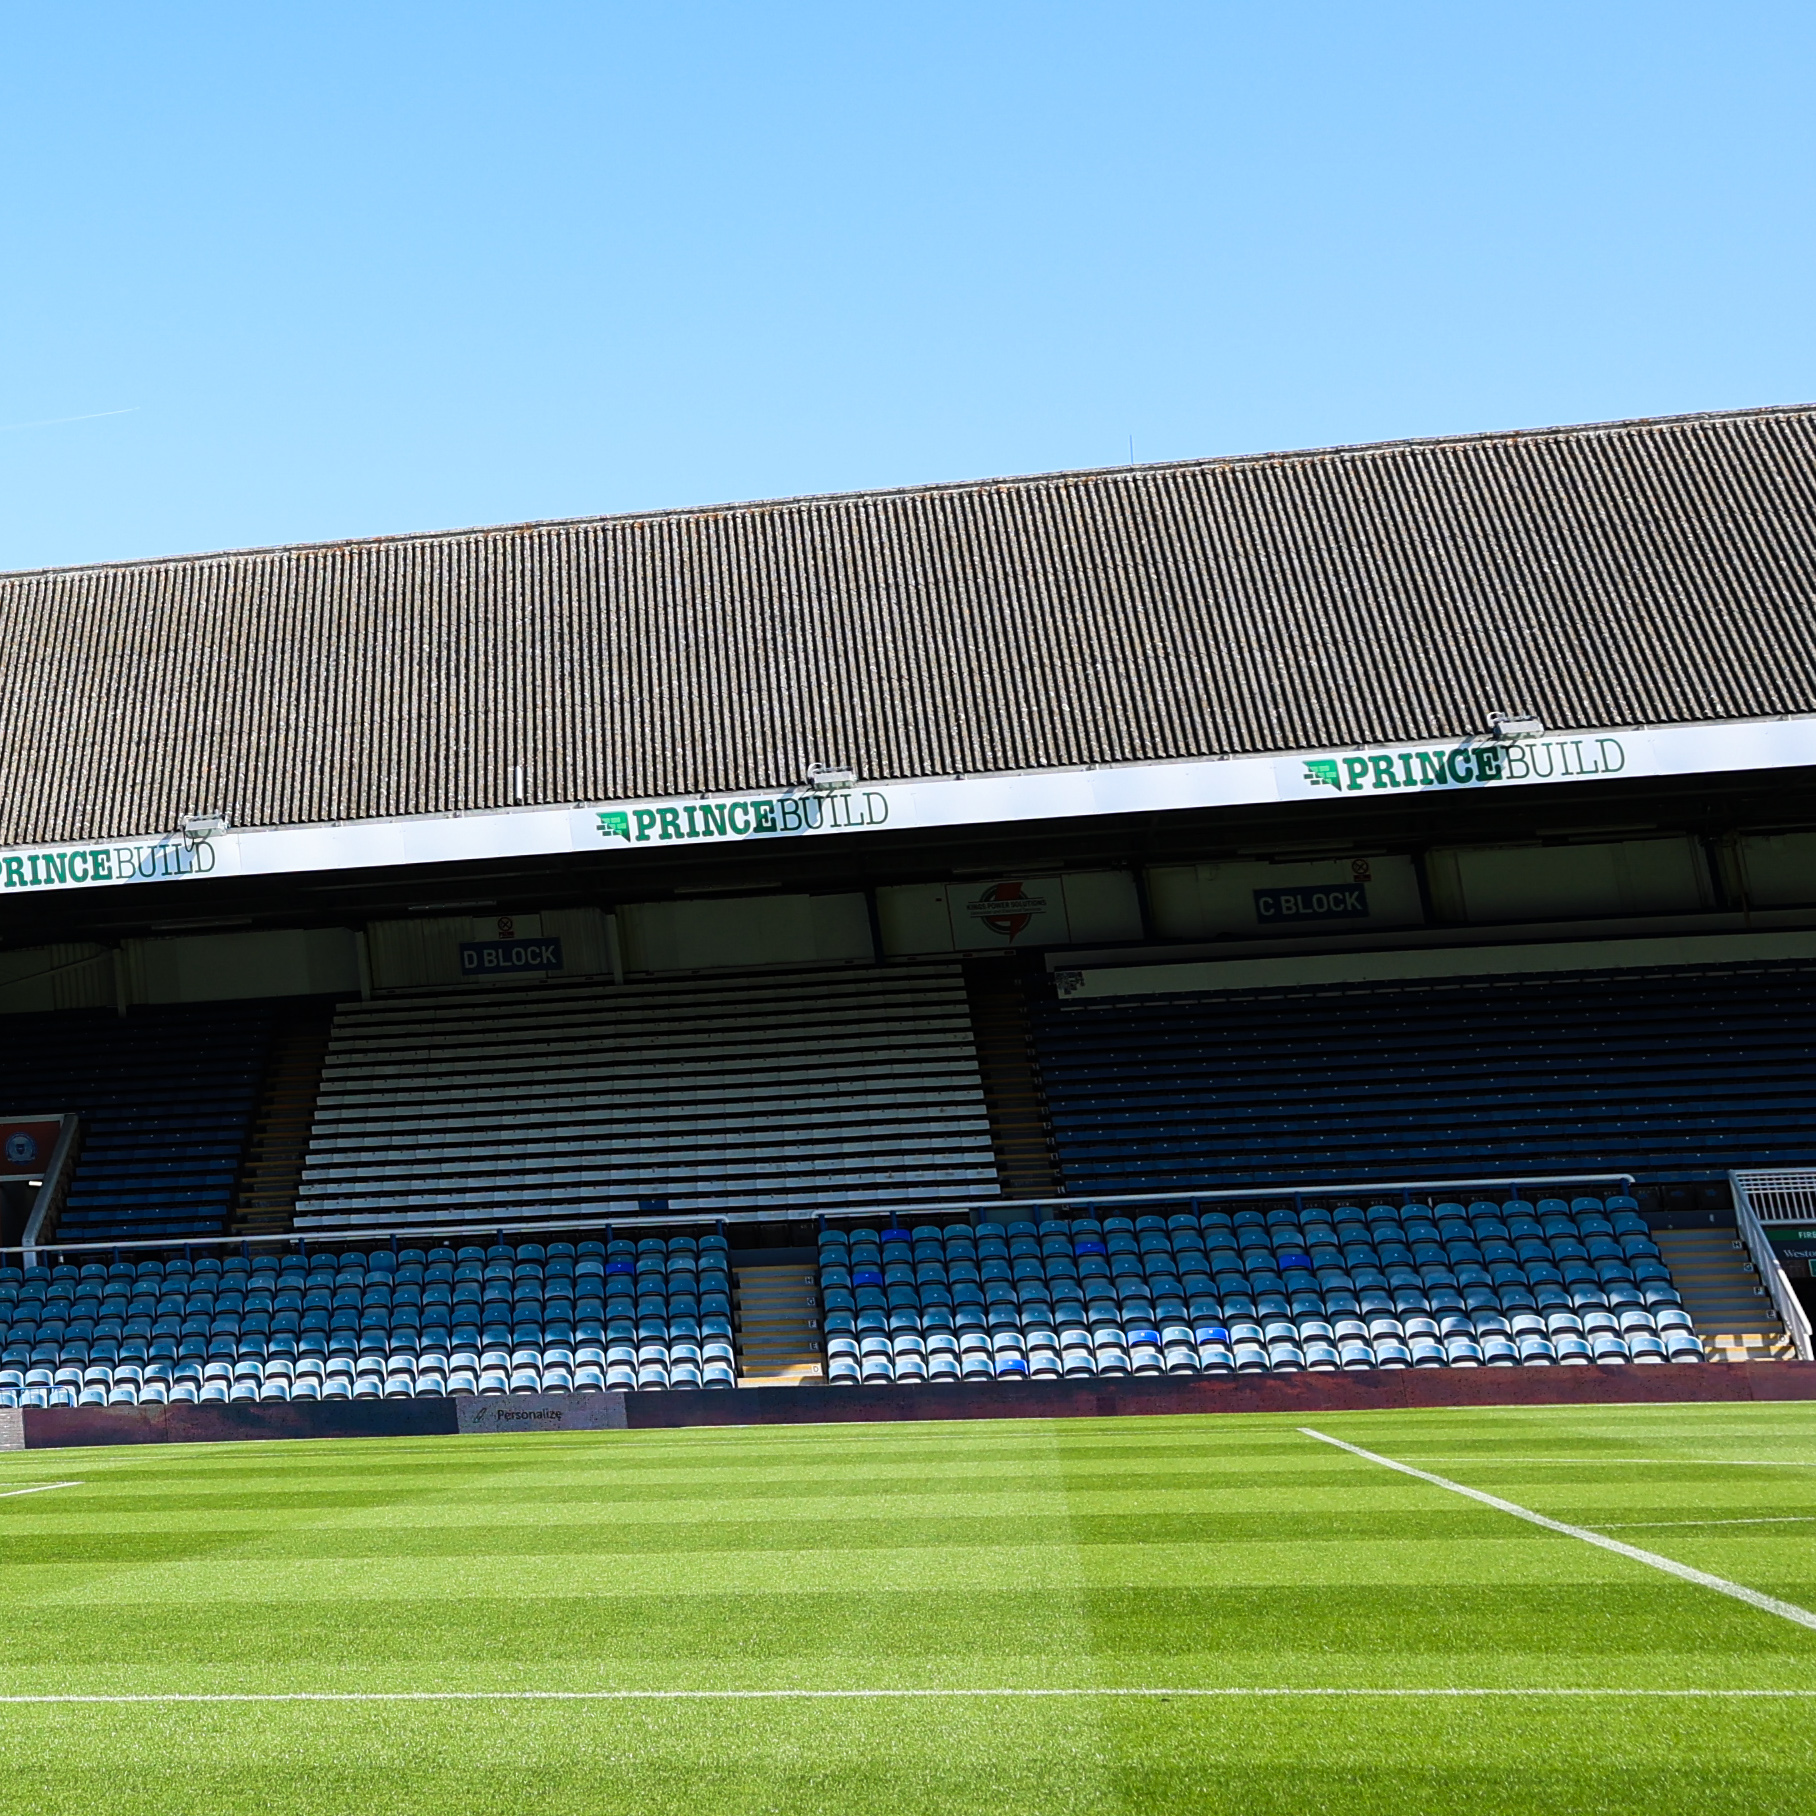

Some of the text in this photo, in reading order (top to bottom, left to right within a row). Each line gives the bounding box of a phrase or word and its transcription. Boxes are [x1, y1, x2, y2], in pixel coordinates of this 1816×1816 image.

[1342, 739, 1626, 791] PRINCEBUILD
[634, 790, 889, 842] PRINCEBUILD
[1259, 890, 1364, 916] C BLOCK
[464, 945, 557, 969] D BLOCK
[1783, 1249, 1816, 1258] Westo
[497, 1408, 562, 1421] Personalize
